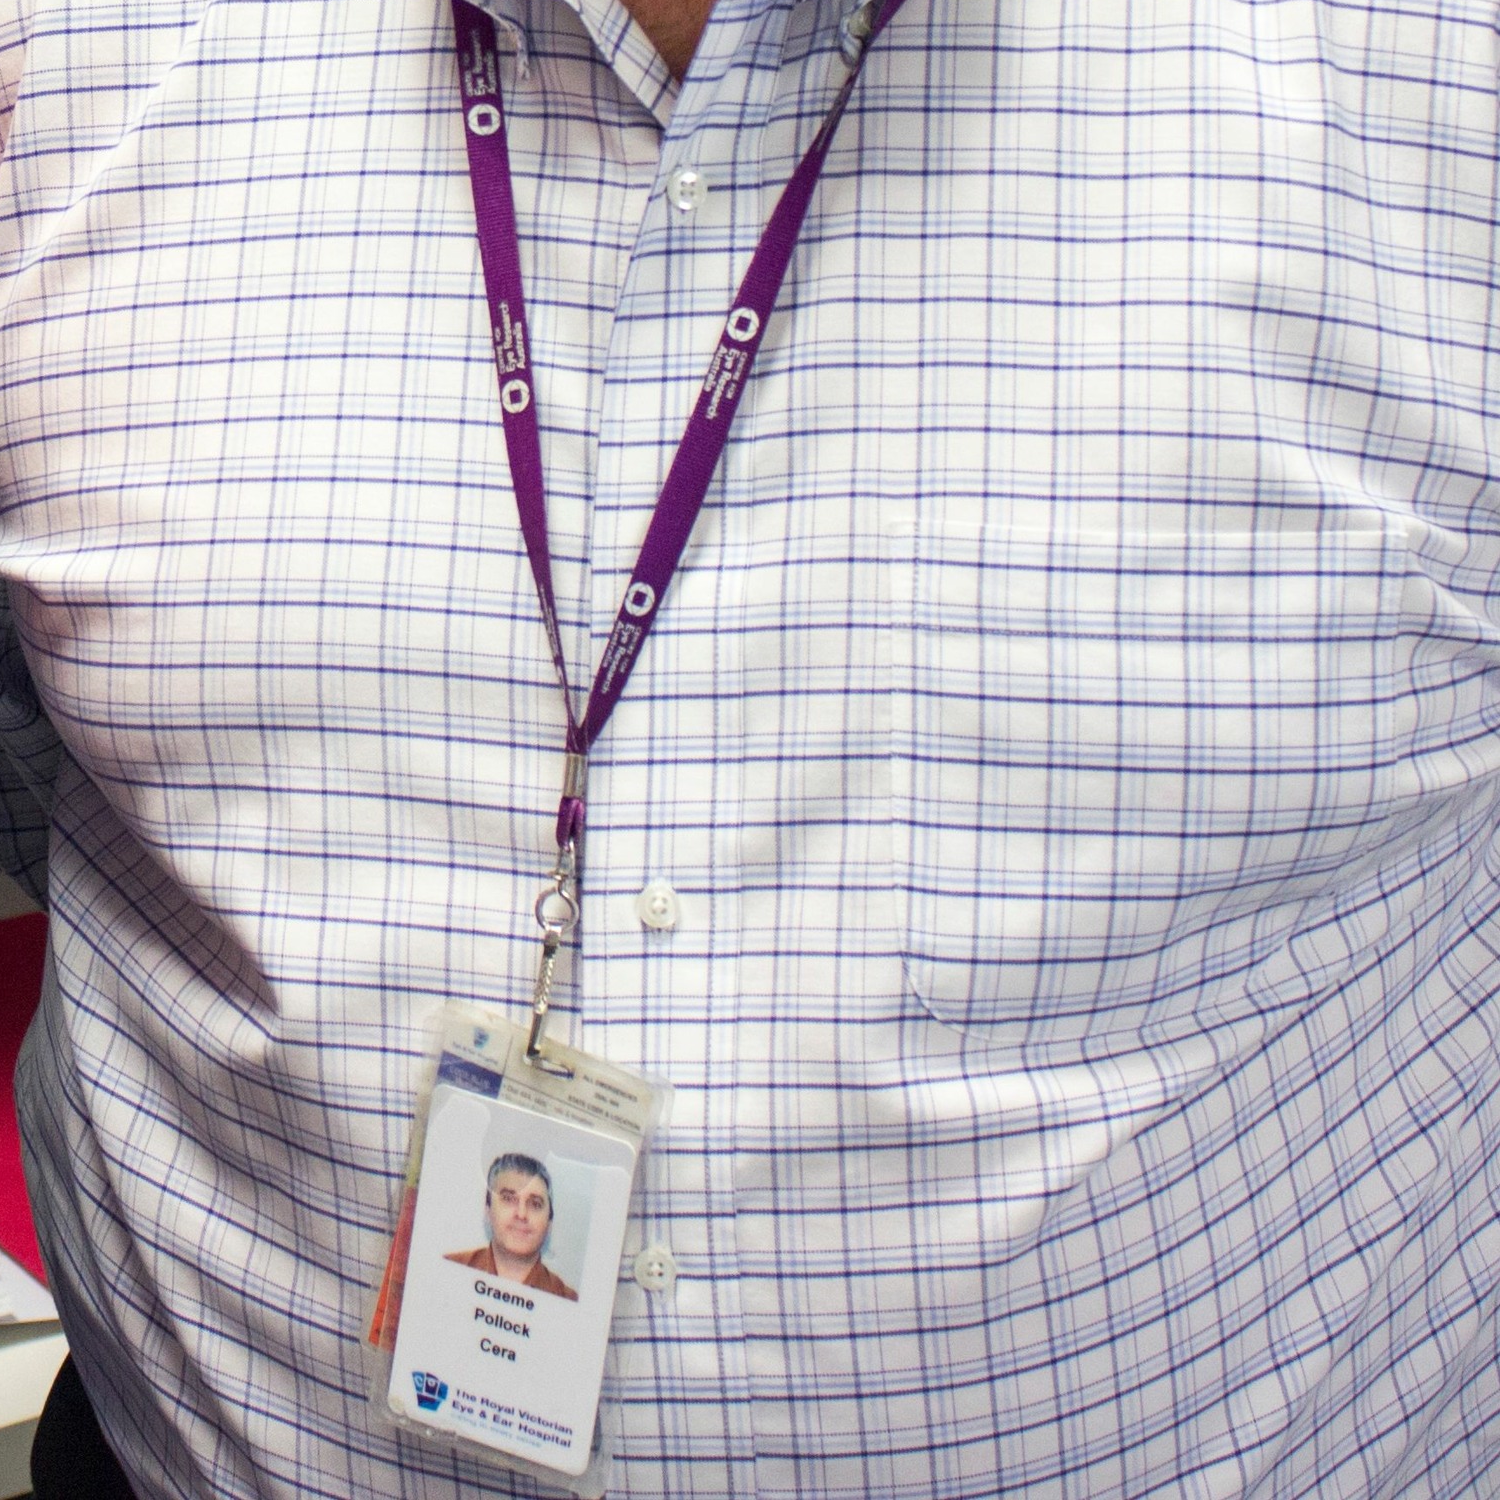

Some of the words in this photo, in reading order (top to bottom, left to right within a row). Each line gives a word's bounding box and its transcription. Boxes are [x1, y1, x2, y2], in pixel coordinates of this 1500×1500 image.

[499, 302, 513, 350] Research
[505, 351, 517, 373] Eye
[724, 348, 740, 370] Eye
[705, 370, 732, 420] Research
[474, 1280, 535, 1311] Graeme
[474, 1307, 530, 1338] Pollock
[480, 1338, 516, 1361] Cera
[451, 1400, 474, 1415] Eye
[479, 1410, 487, 1419] &
[492, 1414, 514, 1428] Ear
[518, 1422, 572, 1448] Hospital
[456, 1388, 477, 1402] The
[480, 1397, 515, 1416] Royal
[518, 1409, 573, 1435] Victorian
